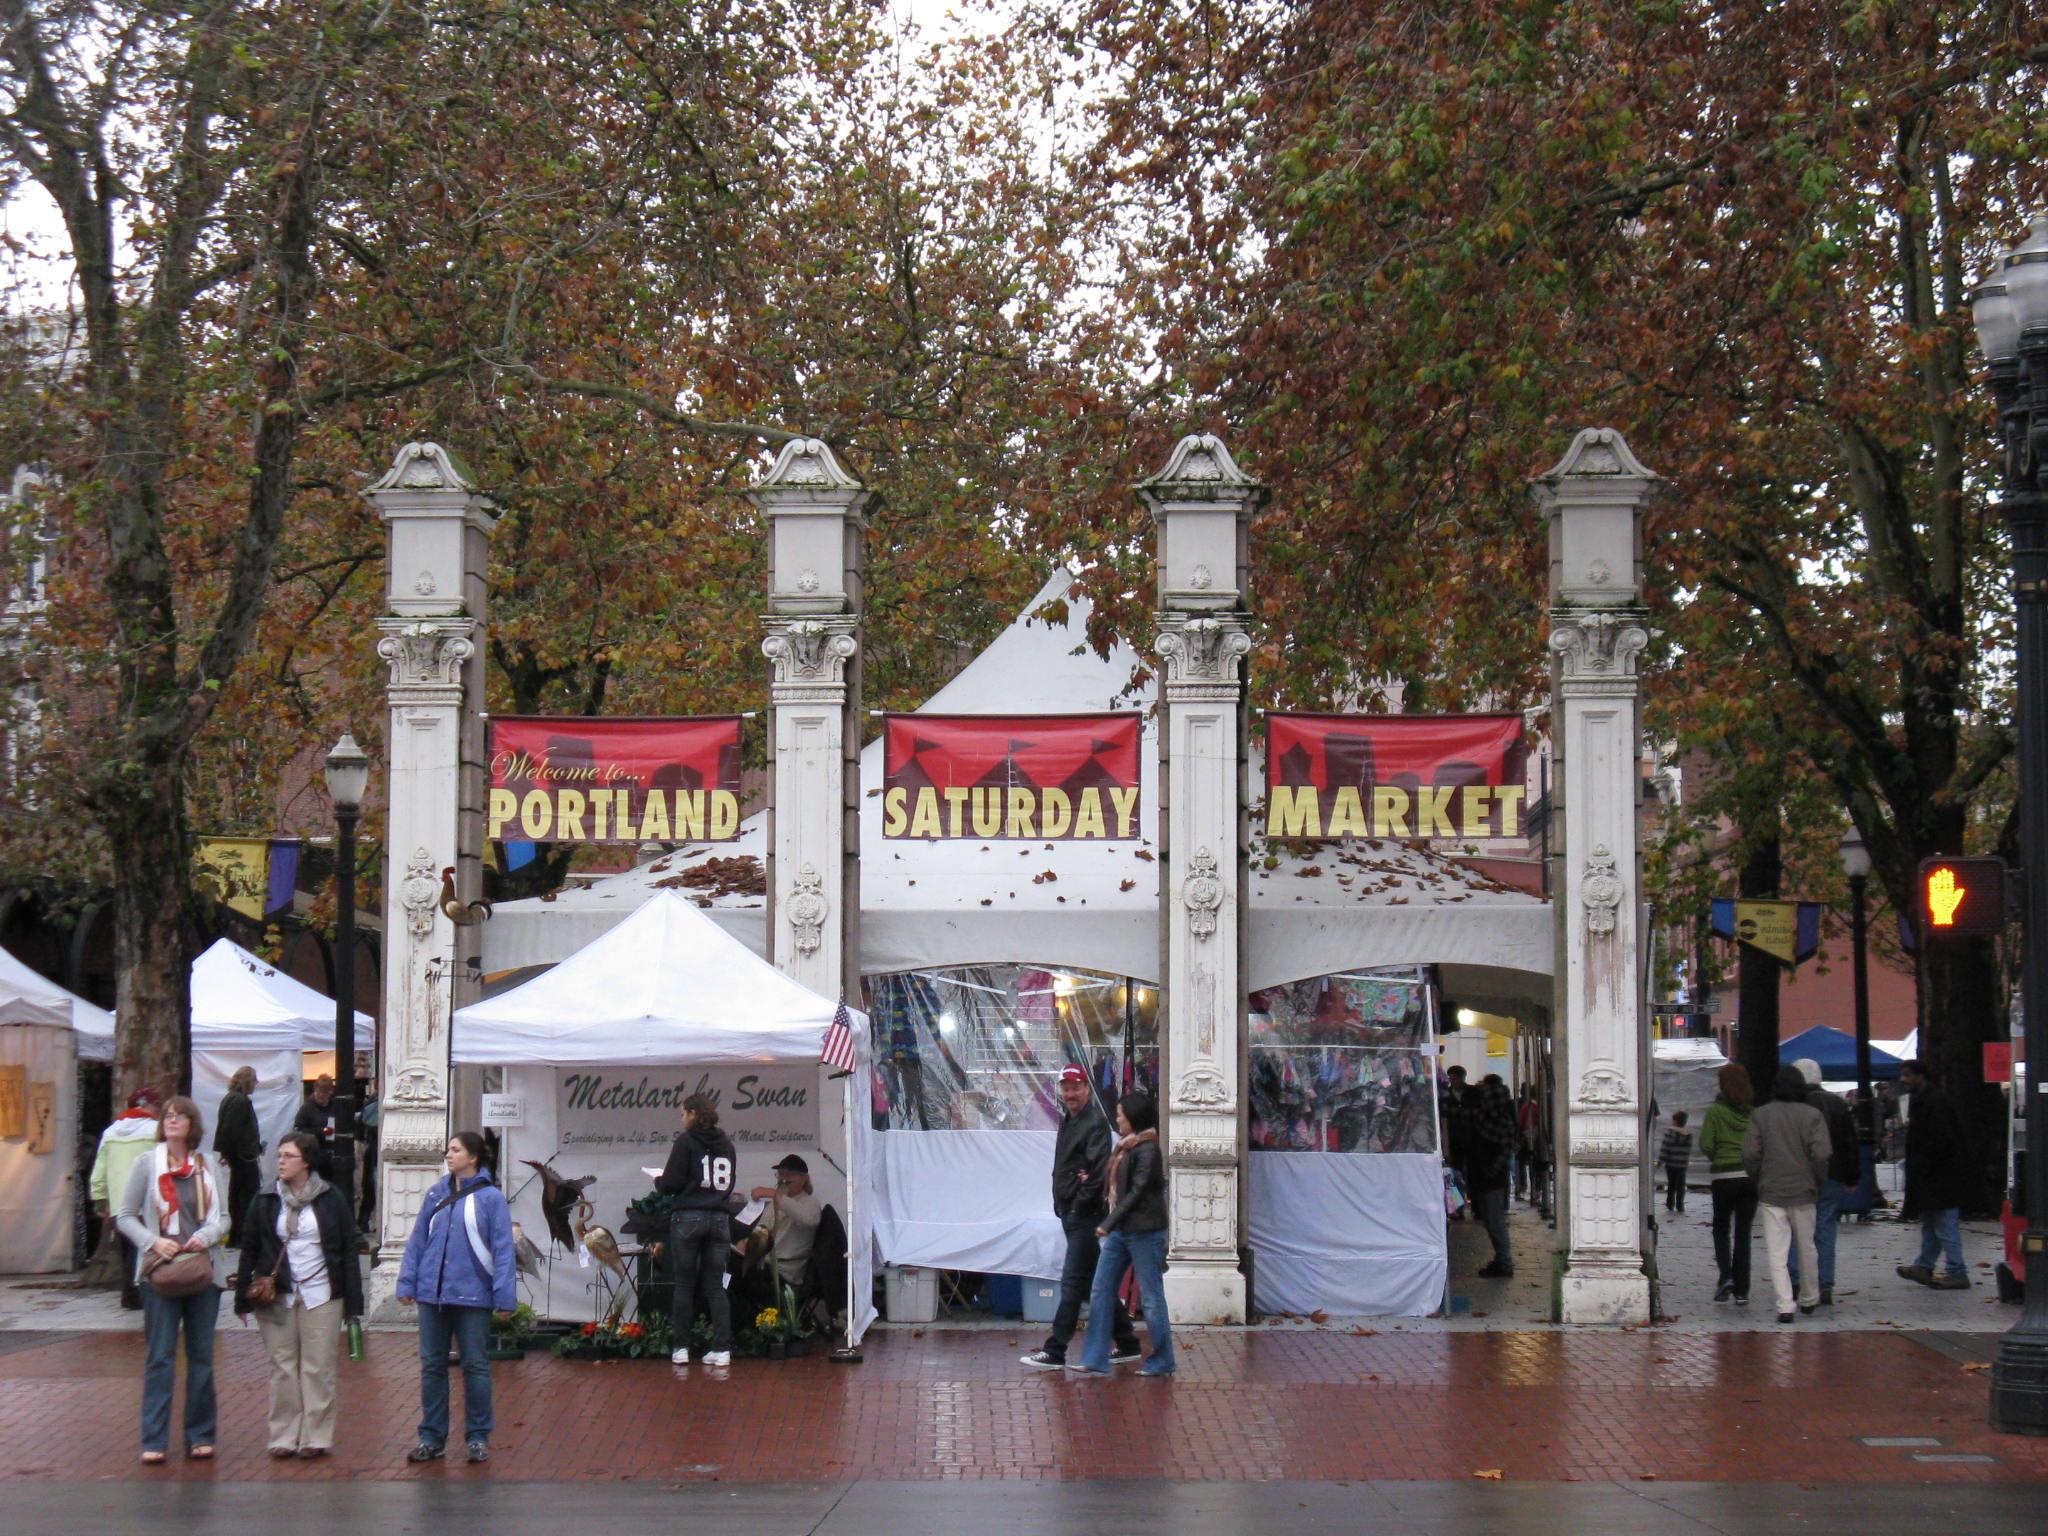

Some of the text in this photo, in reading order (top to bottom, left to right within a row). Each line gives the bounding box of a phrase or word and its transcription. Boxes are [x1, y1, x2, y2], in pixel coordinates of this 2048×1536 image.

[490, 746, 647, 782] Welcome to...
[488, 787, 739, 841] PORTLAND
[884, 786, 1139, 838] SATURDAY
[1267, 784, 1526, 838] MARKET
[564, 1073, 685, 1111] Metalart
[732, 1075, 807, 1111] Swan
[627, 1129, 646, 1146] Life
[649, 1131, 668, 1145] Size
[738, 1128, 766, 1143] Metal
[699, 1154, 732, 1191] 18
